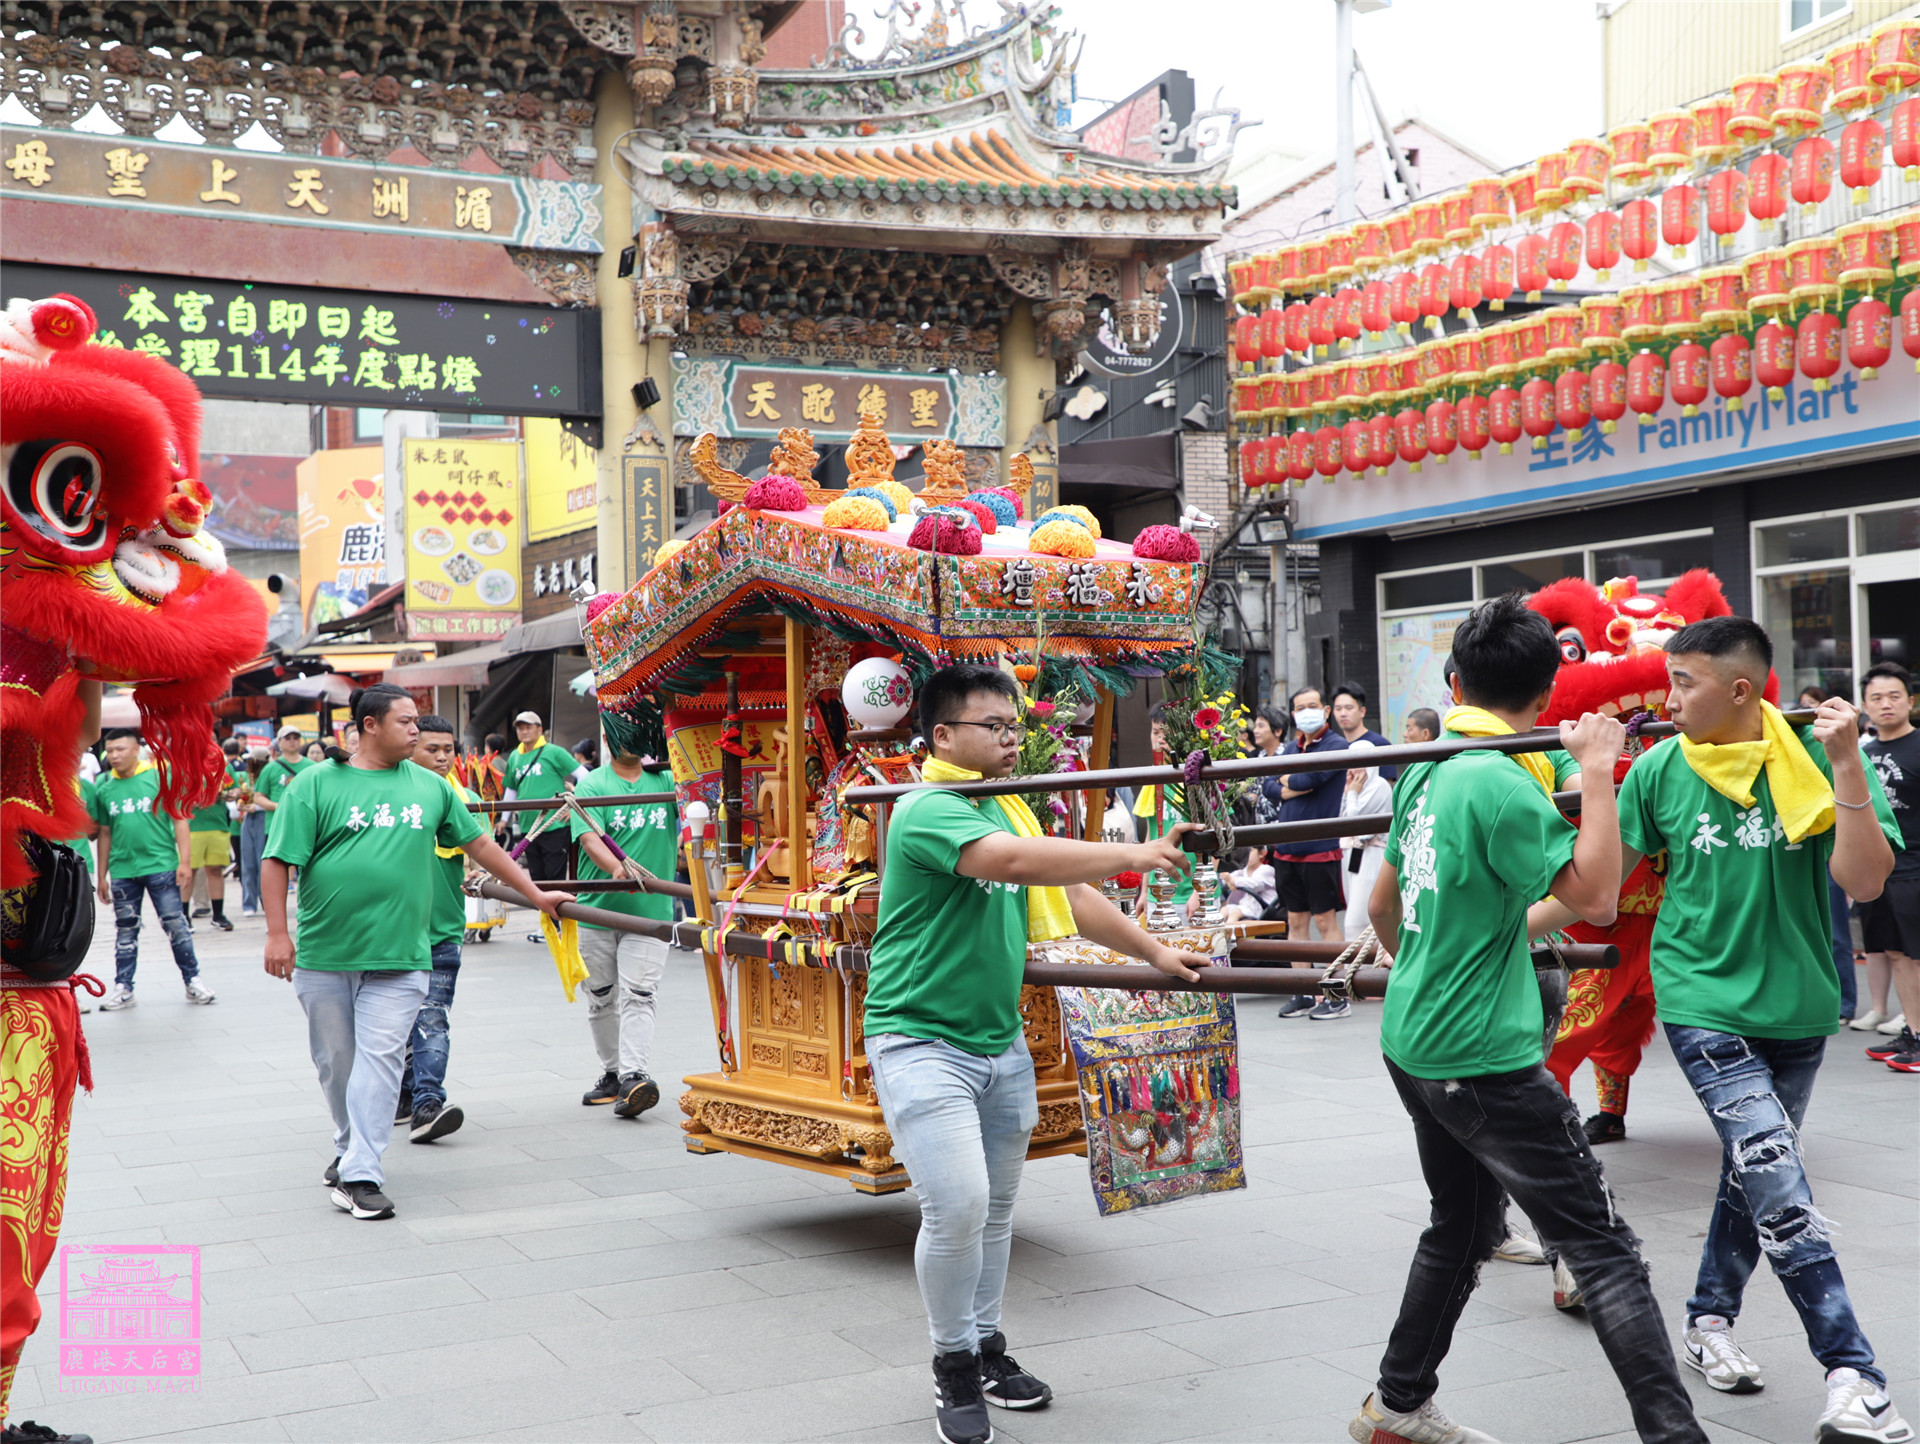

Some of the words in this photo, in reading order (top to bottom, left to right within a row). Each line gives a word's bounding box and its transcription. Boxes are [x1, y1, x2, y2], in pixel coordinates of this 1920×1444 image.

[123, 286, 400, 345] 本宮自即日起
[87, 331, 482, 393] 受理114年度點燈
[1638, 371, 1859, 454] FamilyMart
[639, 476, 659, 575] 天上天水
[109, 796, 152, 816] 永福壇
[345, 803, 424, 832] 永福壇
[608, 807, 668, 831] 永福壇
